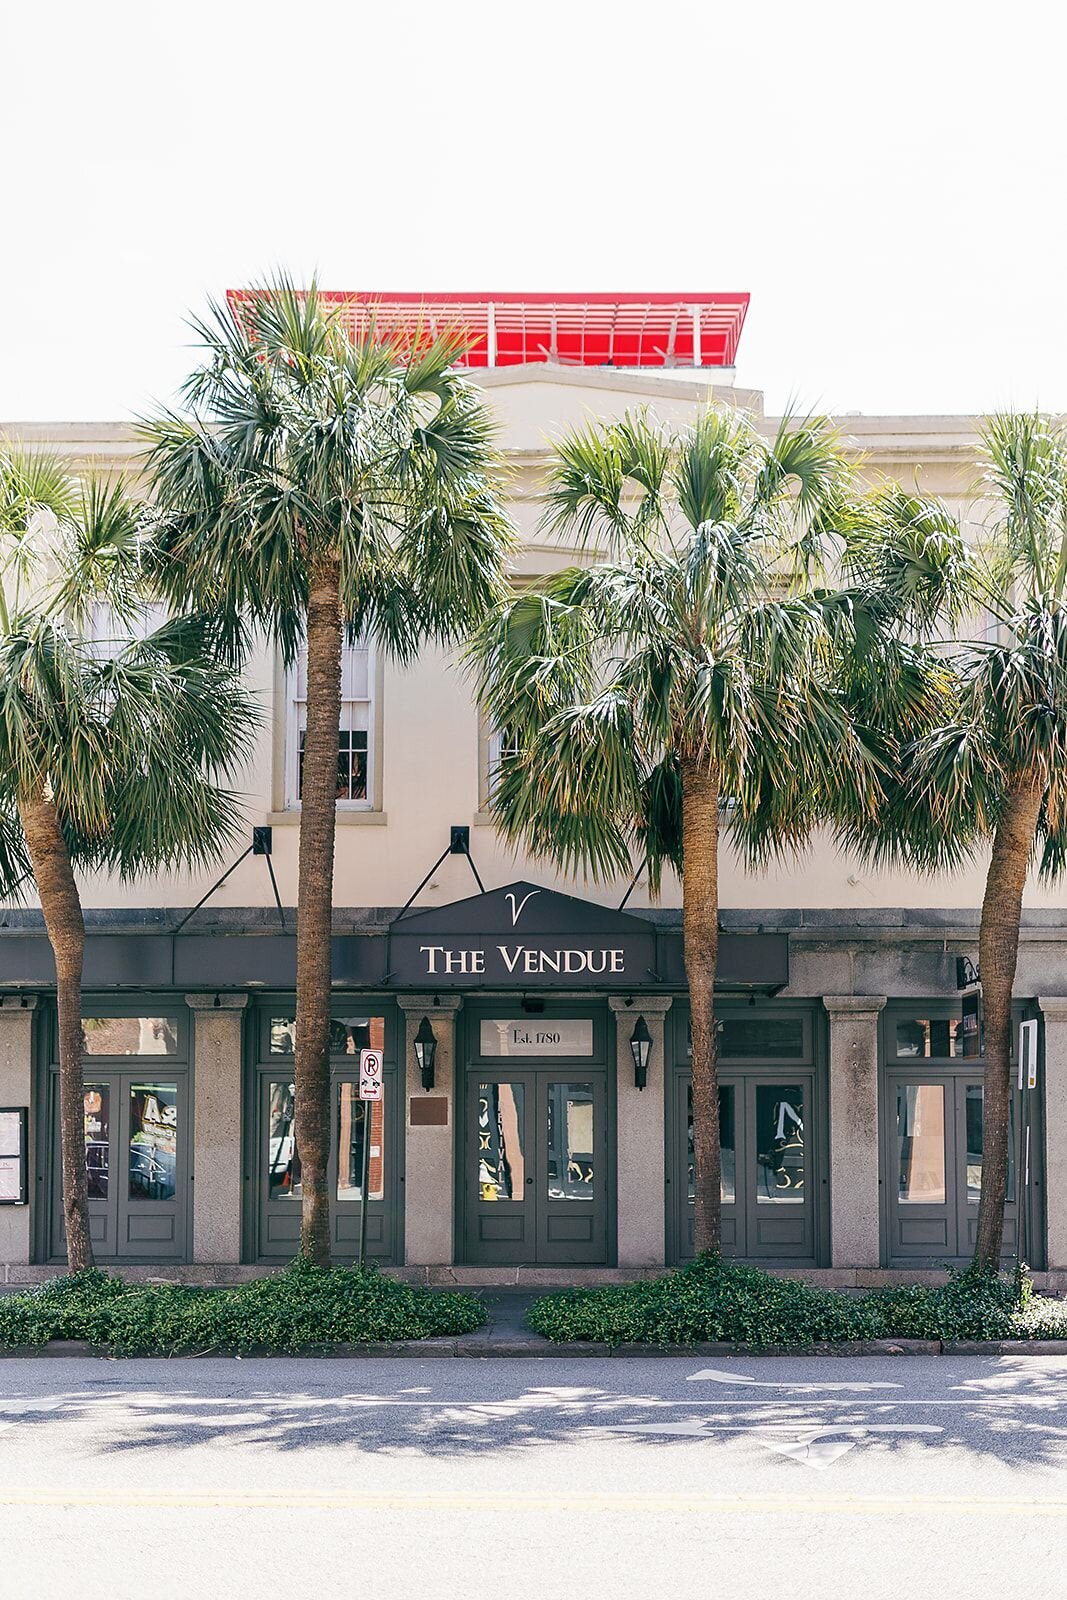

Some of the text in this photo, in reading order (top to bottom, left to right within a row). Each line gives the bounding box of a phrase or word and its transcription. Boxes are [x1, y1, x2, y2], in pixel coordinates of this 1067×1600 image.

[504, 890, 541, 927] V
[513, 1029, 561, 1044] Est. 1780
